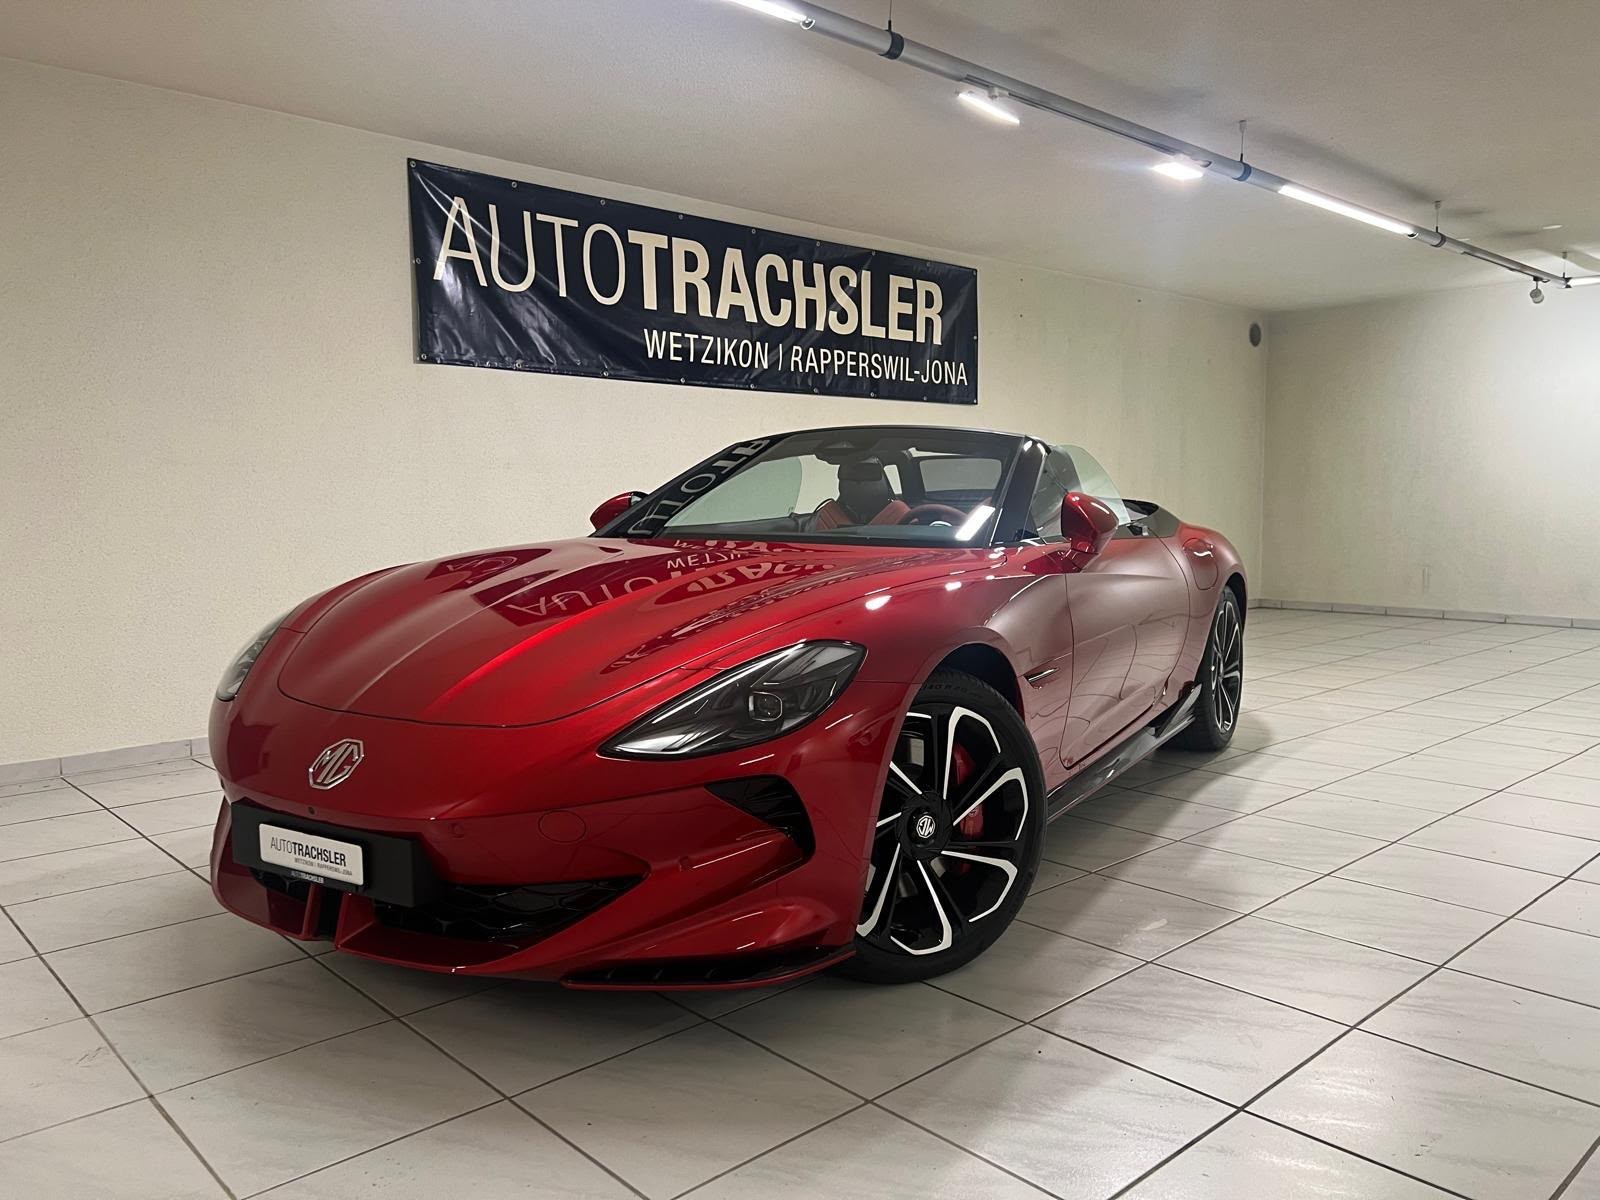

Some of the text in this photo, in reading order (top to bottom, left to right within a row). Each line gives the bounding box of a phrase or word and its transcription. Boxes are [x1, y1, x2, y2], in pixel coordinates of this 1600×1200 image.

[643, 328, 769, 369] WETZIKON
[790, 347, 968, 386] RAPPERSWIL-JONA
[311, 741, 361, 786] MG
